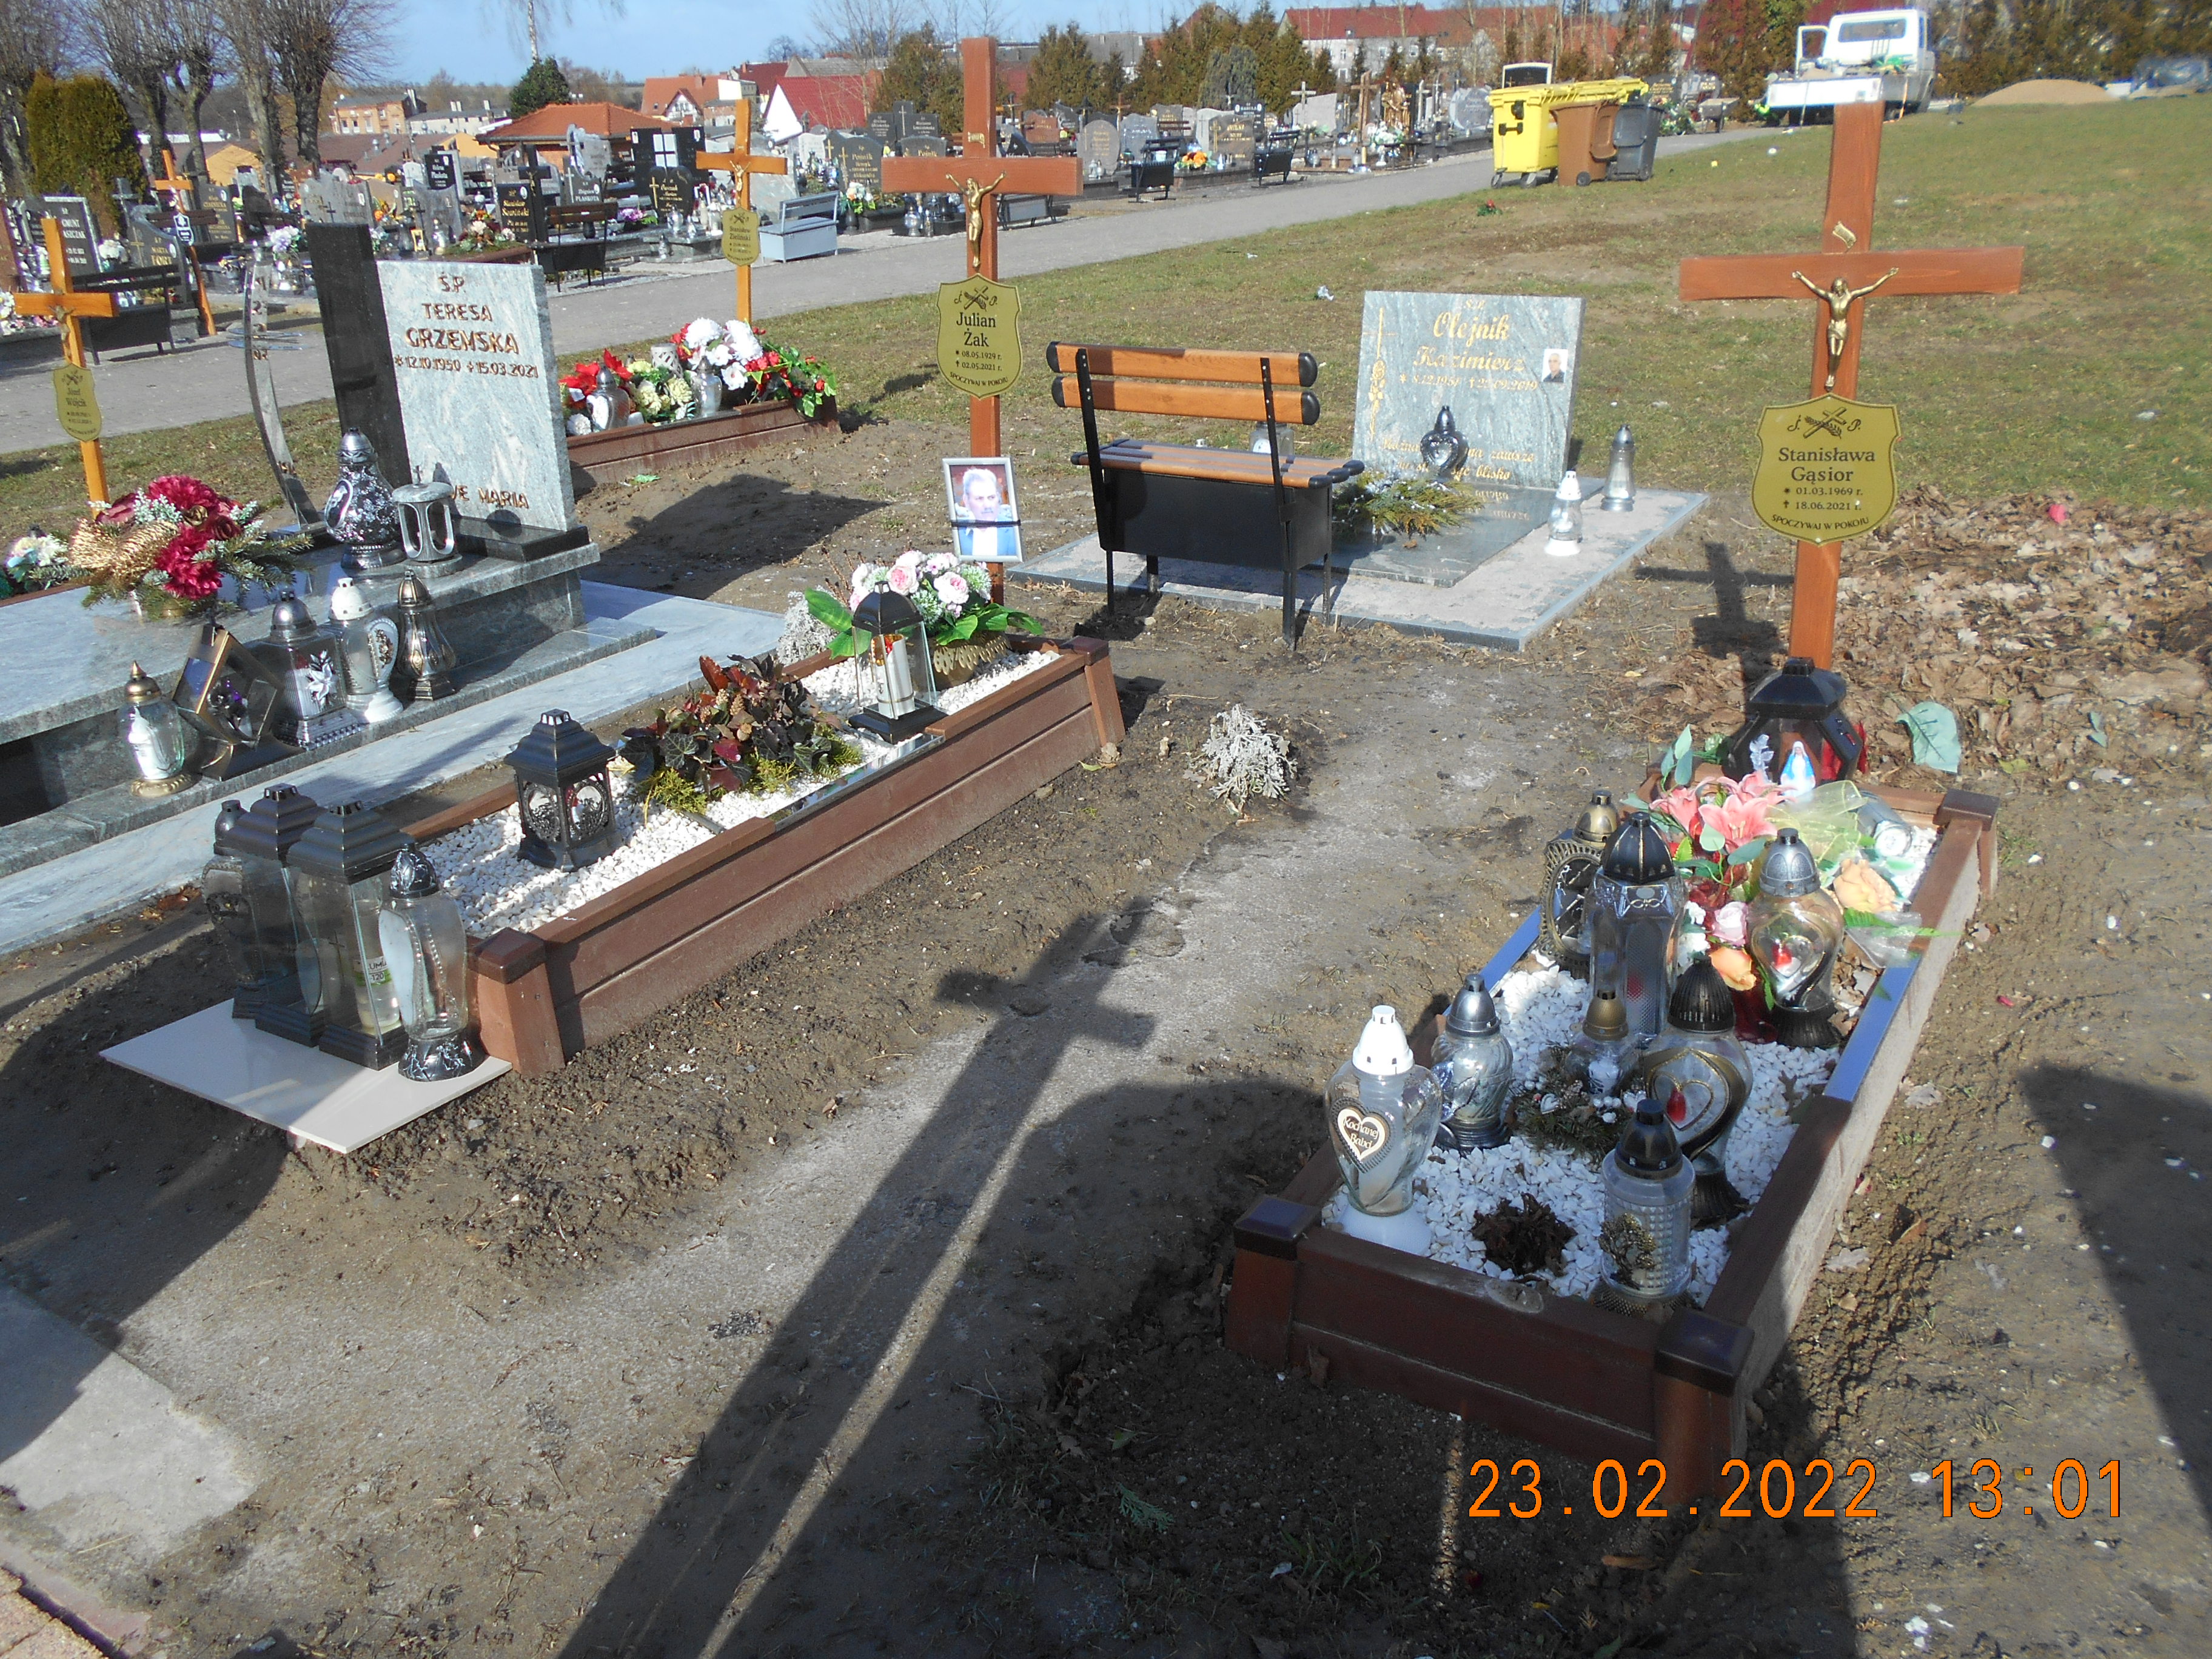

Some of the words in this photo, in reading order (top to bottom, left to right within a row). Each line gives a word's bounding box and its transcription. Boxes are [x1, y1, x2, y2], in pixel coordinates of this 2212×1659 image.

[421, 303, 493, 322] TERESA
[956, 312, 996, 328] Julian
[964, 328, 989, 347] Żak
[1433, 312, 1510, 347] Olejnik
[405, 327, 519, 355] GRZEMSKA
[962, 350, 996, 360] 08.05.1929
[1413, 345, 1525, 372] Kazimierz
[950, 372, 980, 386] SPOCZYWAJ
[988, 377, 1008, 386] POKOJU
[1778, 447, 1875, 462] Stanisława
[1475, 464, 1512, 480] blisko
[1791, 466, 1854, 484] Gąsior
[478, 486, 529, 509] MARIA
[1795, 487, 1853, 495] 01.03.1969
[1795, 501, 1851, 511] 18.06.2021
[1772, 514, 1822, 530] SPOCZYWAJ
[1835, 517, 1869, 530] POKOJU
[1343, 1118, 1379, 1140] Kochanej
